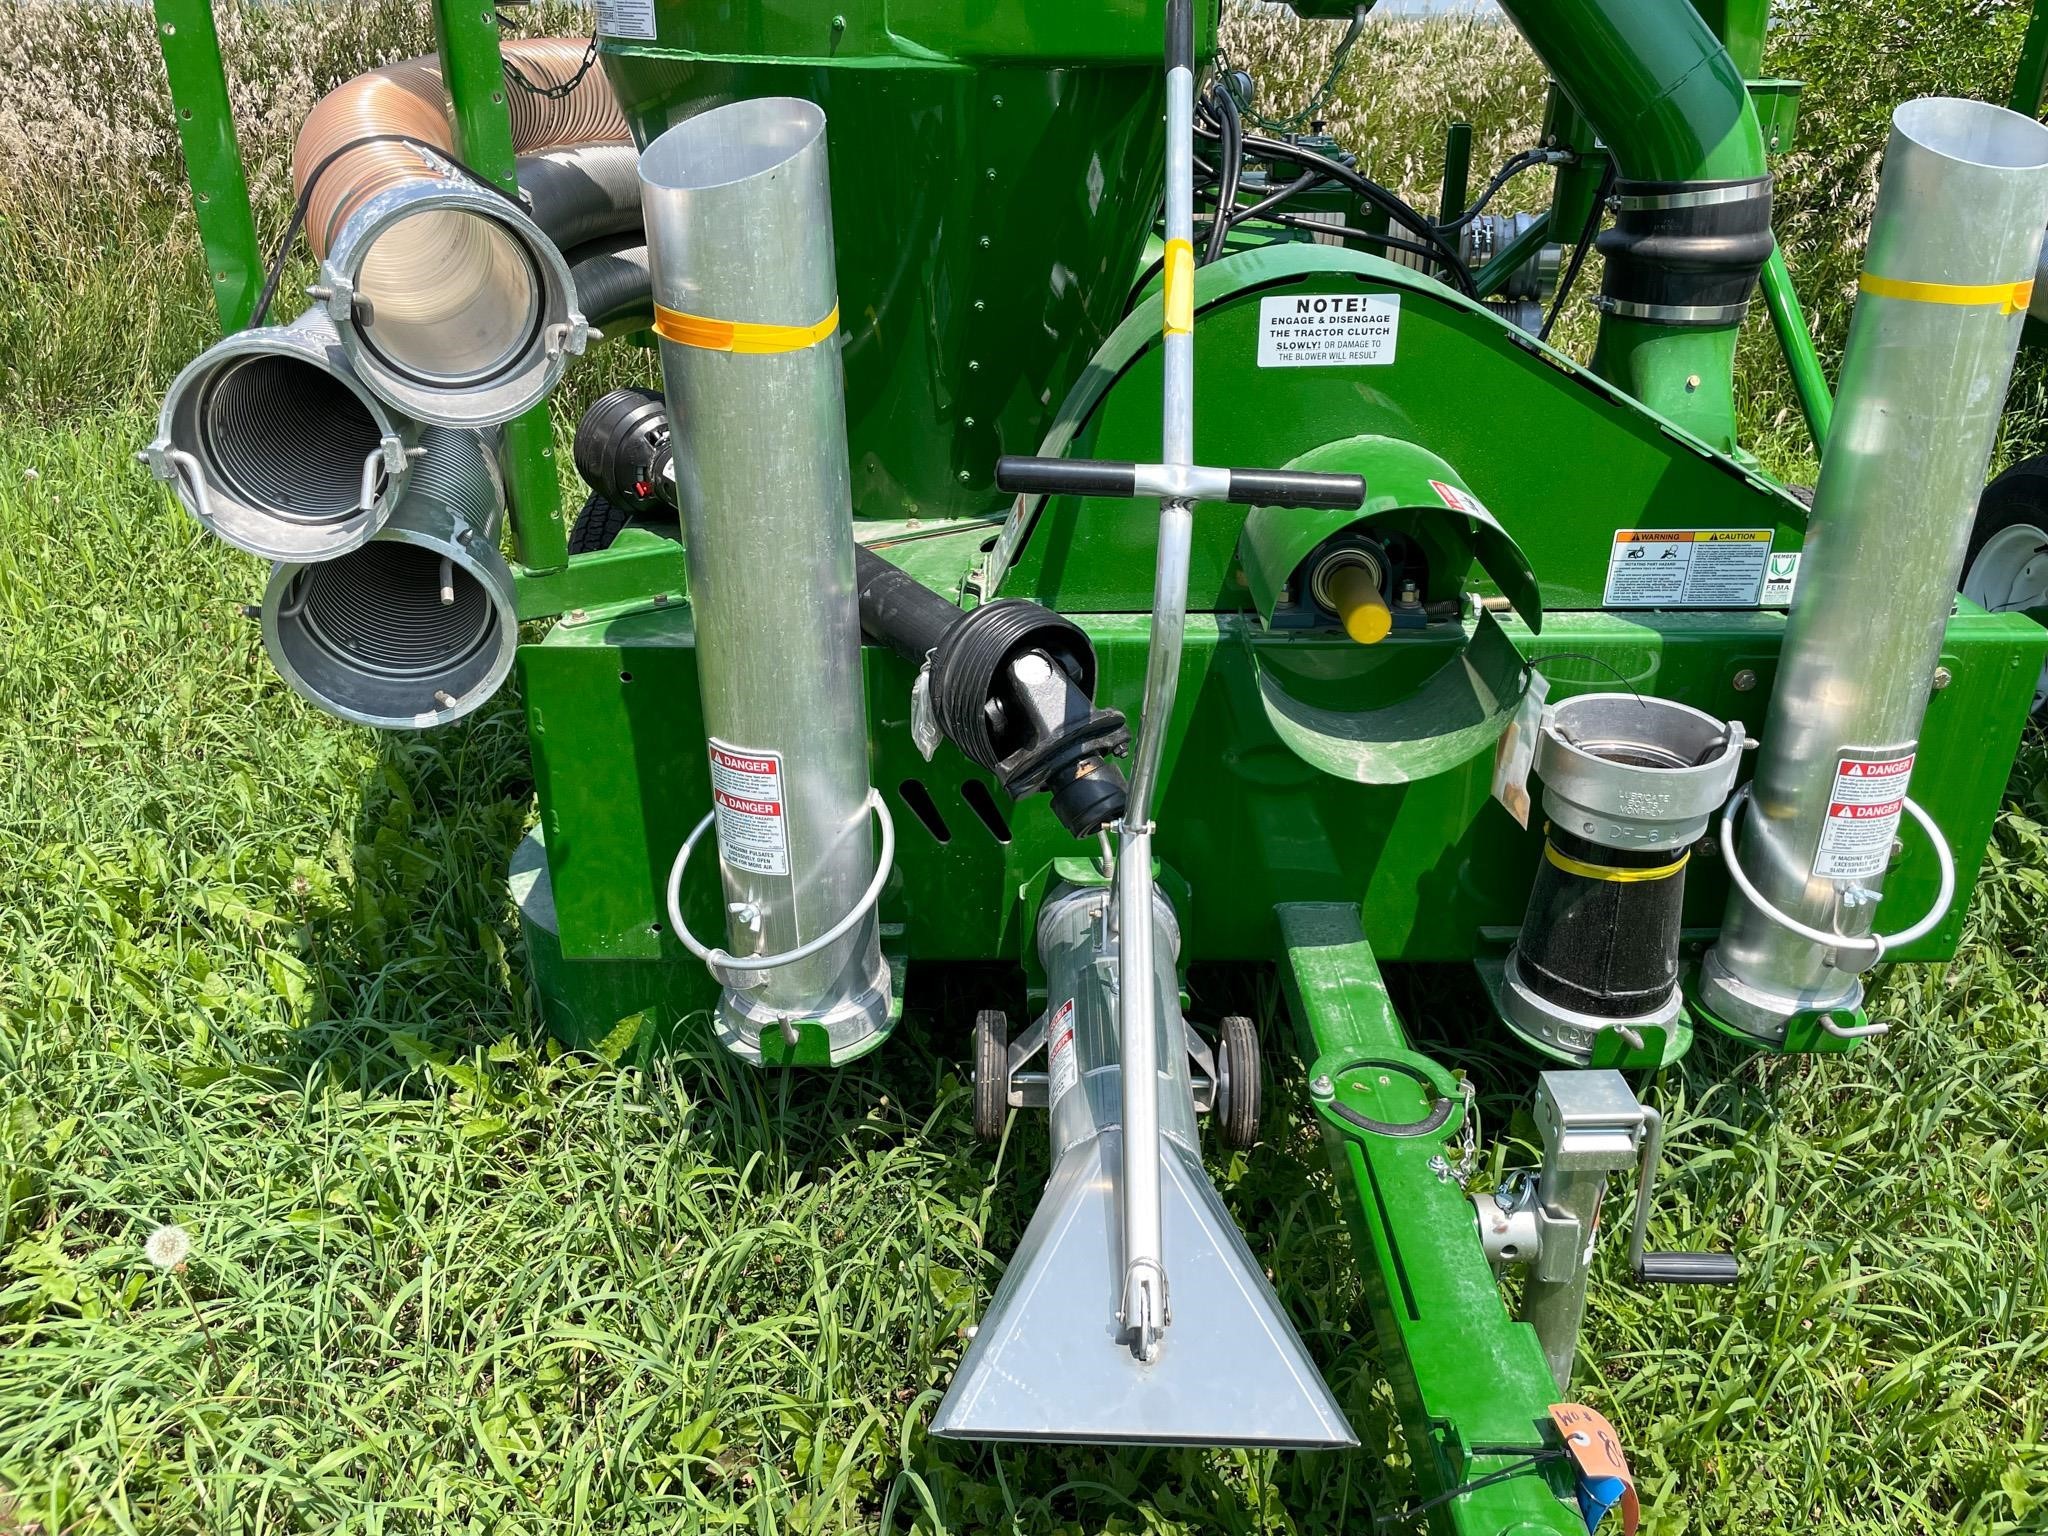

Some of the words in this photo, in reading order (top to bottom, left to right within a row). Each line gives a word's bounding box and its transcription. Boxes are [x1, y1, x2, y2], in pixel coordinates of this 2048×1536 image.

[1296, 298, 1367, 313] NOTE!
[1271, 317, 1315, 325] ENGAGE
[1318, 316, 1325, 324] &
[1329, 315, 1390, 324] DISENGAGE
[1270, 330, 1290, 338] THE
[1295, 329, 1344, 337] TRACTOR
[1347, 328, 1390, 336] CLUTCH
[1276, 342, 1321, 350] SLOWLY!
[1324, 341, 1335, 349] OR
[1337, 340, 1369, 348] DAMAGE
[1372, 340, 1381, 348] TO
[1279, 353, 1293, 361] THE
[1295, 352, 1327, 360] BLOWER
[1329, 352, 1347, 360] WILL
[1349, 351, 1378, 359] RESULT
[724, 756, 770, 772] DANGER
[1866, 761, 1910, 775] DANGER
[1618, 791, 1670, 803] LUBRICATE
[729, 798, 774, 814] DANGER
[1856, 803, 1899, 817] DANGER
